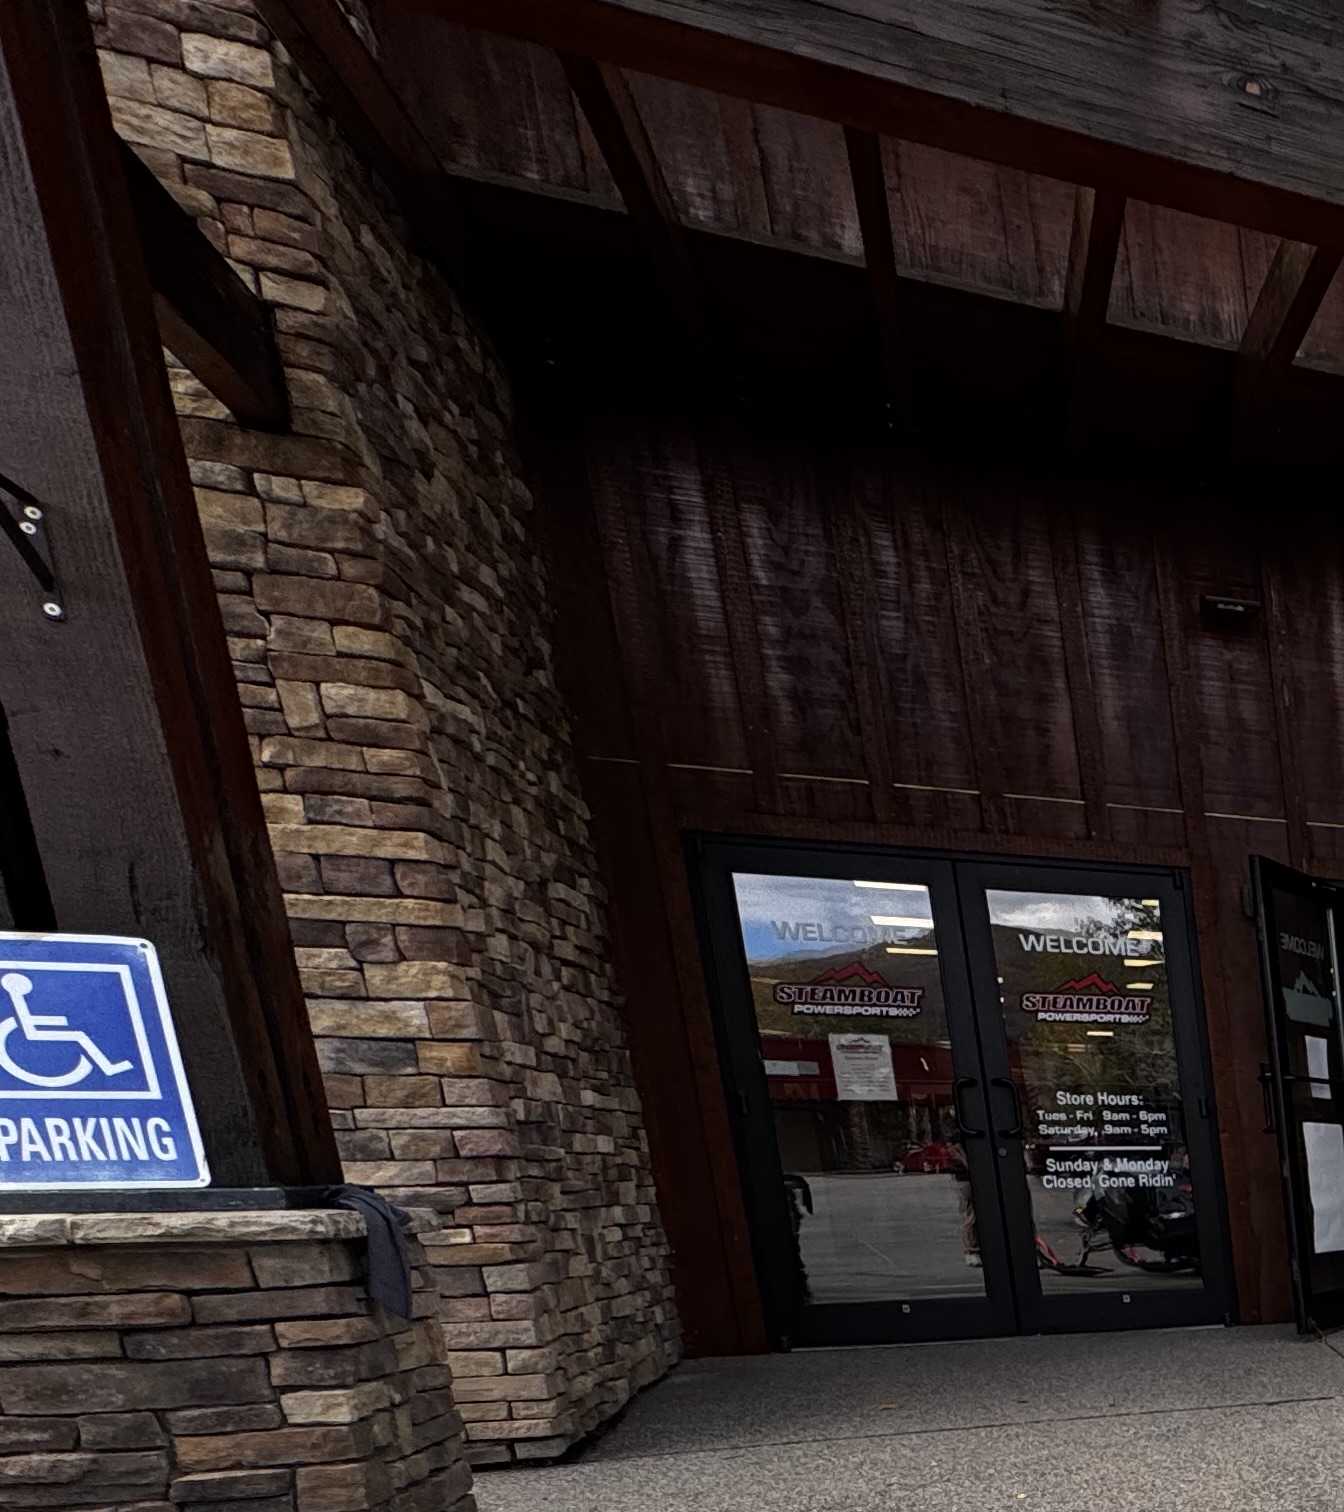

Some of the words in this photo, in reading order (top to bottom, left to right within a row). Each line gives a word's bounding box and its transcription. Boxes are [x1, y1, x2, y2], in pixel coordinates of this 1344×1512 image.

[770, 920, 908, 945] WELCOME
[1019, 933, 1140, 957] WELCOME
[776, 984, 923, 1007] STEAMBOAT
[1022, 993, 1152, 1014] STEAMBOAT
[794, 1005, 898, 1017] POWERSPORTS
[1055, 1090, 1094, 1106] Store
[1097, 1091, 1145, 1106] Hours:
[1076, 1110, 1093, 1121] Fri
[0, 1117, 179, 1162] PARKING
[1046, 1158, 1098, 1175] Sunday
[1103, 1158, 1113, 1172] &
[1115, 1158, 1169, 1174] Monday
[1042, 1174, 1096, 1190] Closed,
[1099, 1175, 1136, 1189] Gone
[1138, 1173, 1176, 1188] Ridin'
